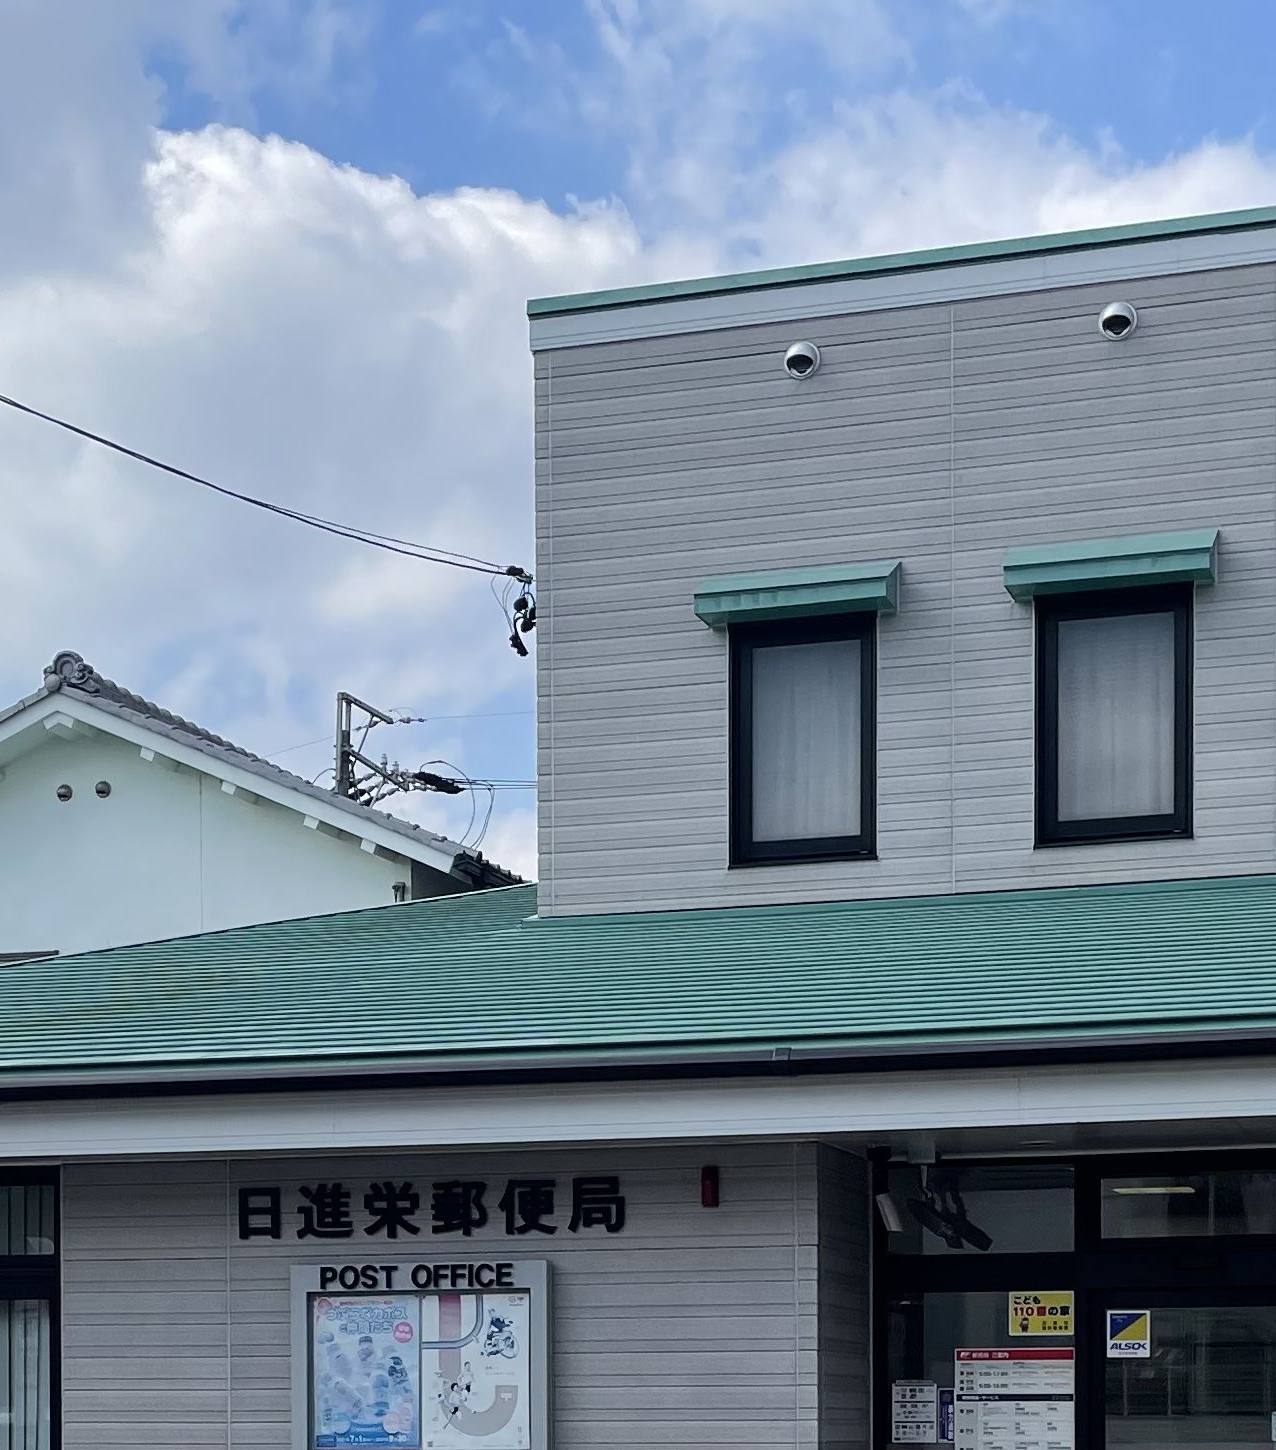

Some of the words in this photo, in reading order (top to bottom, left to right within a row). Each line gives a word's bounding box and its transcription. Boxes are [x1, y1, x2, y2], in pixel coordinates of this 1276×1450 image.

[237, 1175, 627, 1240] 日進栄郵便局
[319, 1264, 399, 1291] POST
[410, 1262, 515, 1290] OFFICE
[1013, 1295, 1042, 1306] こども
[1110, 1342, 1148, 1351] ALSOK
